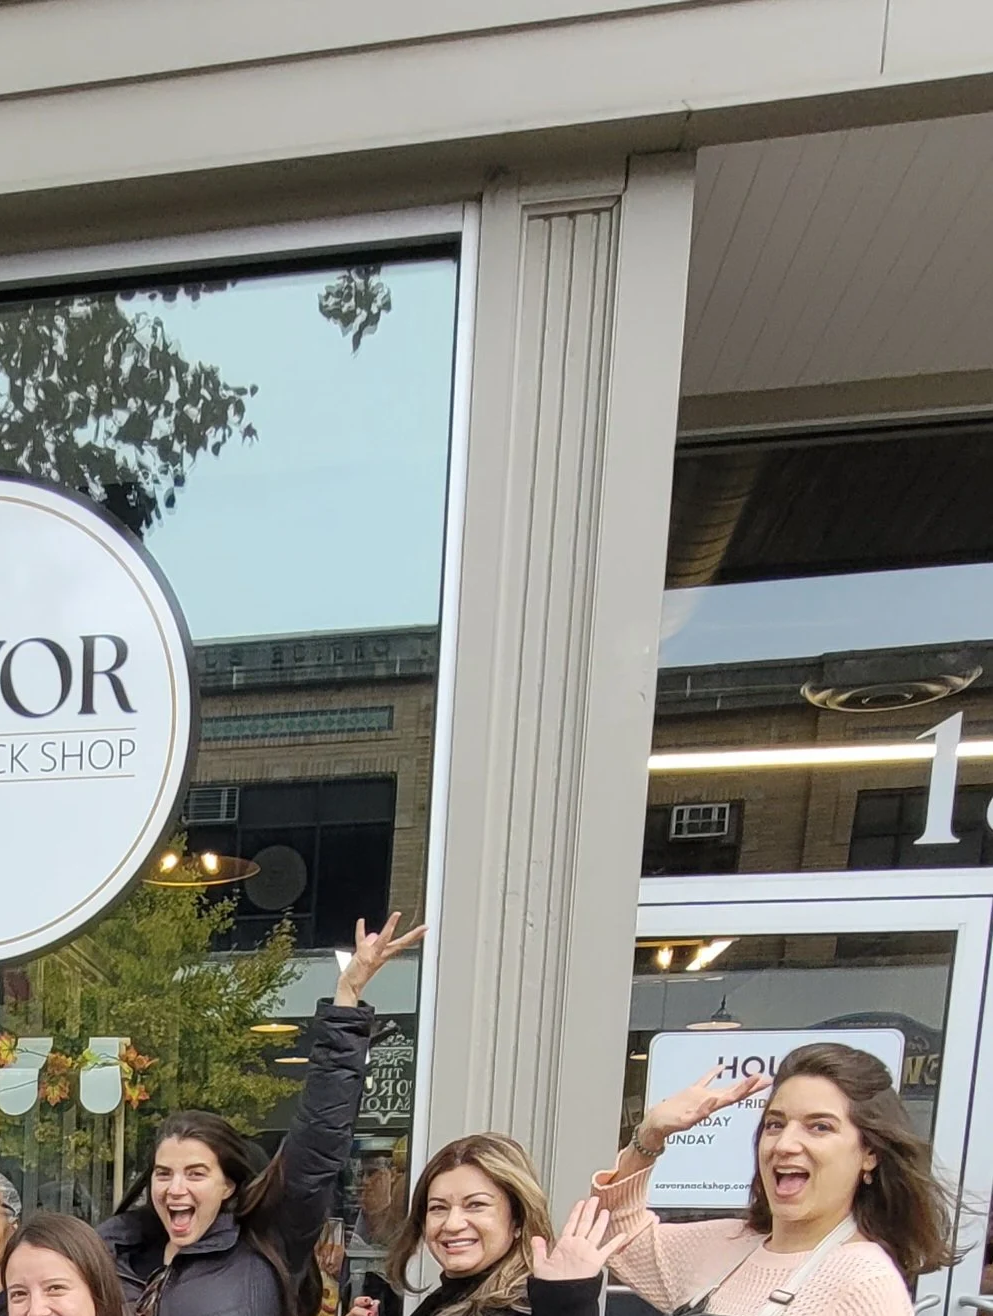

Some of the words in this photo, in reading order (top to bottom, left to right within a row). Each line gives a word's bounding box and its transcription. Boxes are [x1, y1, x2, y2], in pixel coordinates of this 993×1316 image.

[40, 738, 136, 773] SHOP
[913, 711, 993, 845] 1
[737, 1098, 767, 1109] FRID
[666, 1134, 715, 1145] UNDAY
